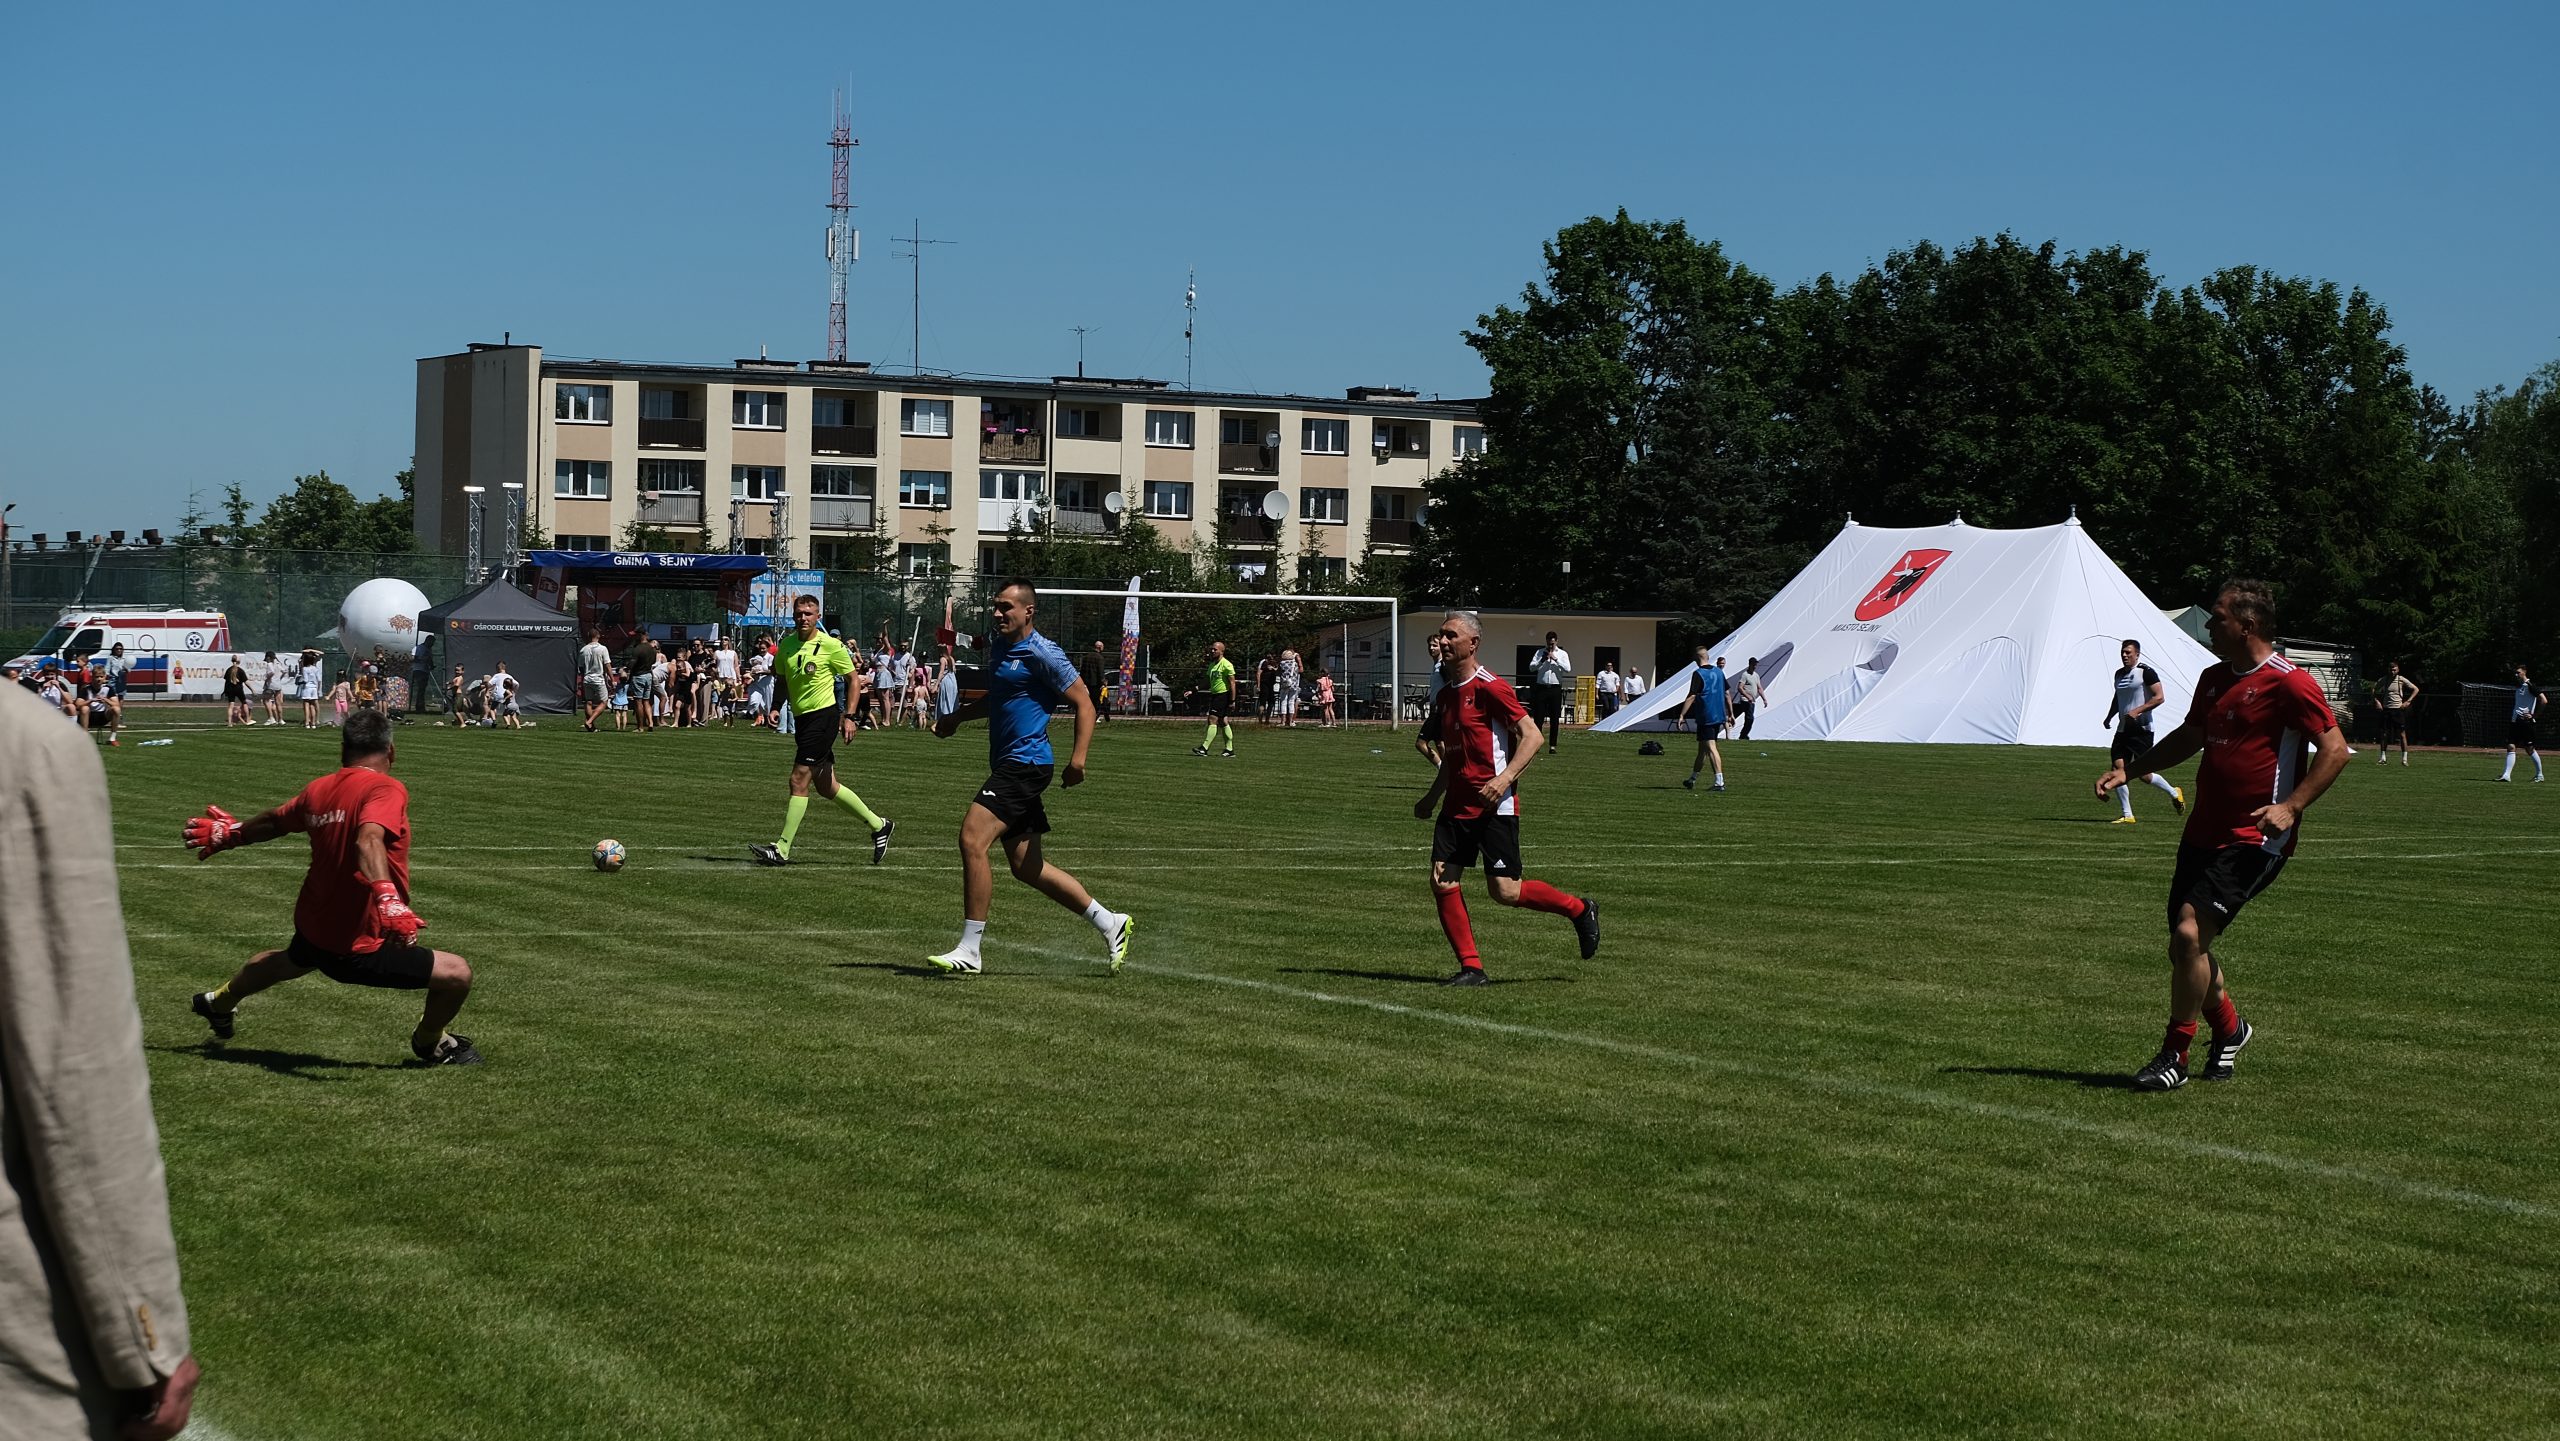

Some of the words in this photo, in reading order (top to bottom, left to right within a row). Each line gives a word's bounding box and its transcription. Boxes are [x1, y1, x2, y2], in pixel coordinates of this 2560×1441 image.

[613, 556, 650, 566] GMINA
[659, 557, 696, 567] SEJNY
[797, 572, 821, 582] telefon
[473, 622, 504, 631] OŚRODEK
[1831, 623, 1860, 631] MIASTO
[1857, 623, 1882, 632] SEJNY
[1710, 671, 1718, 693] 2
